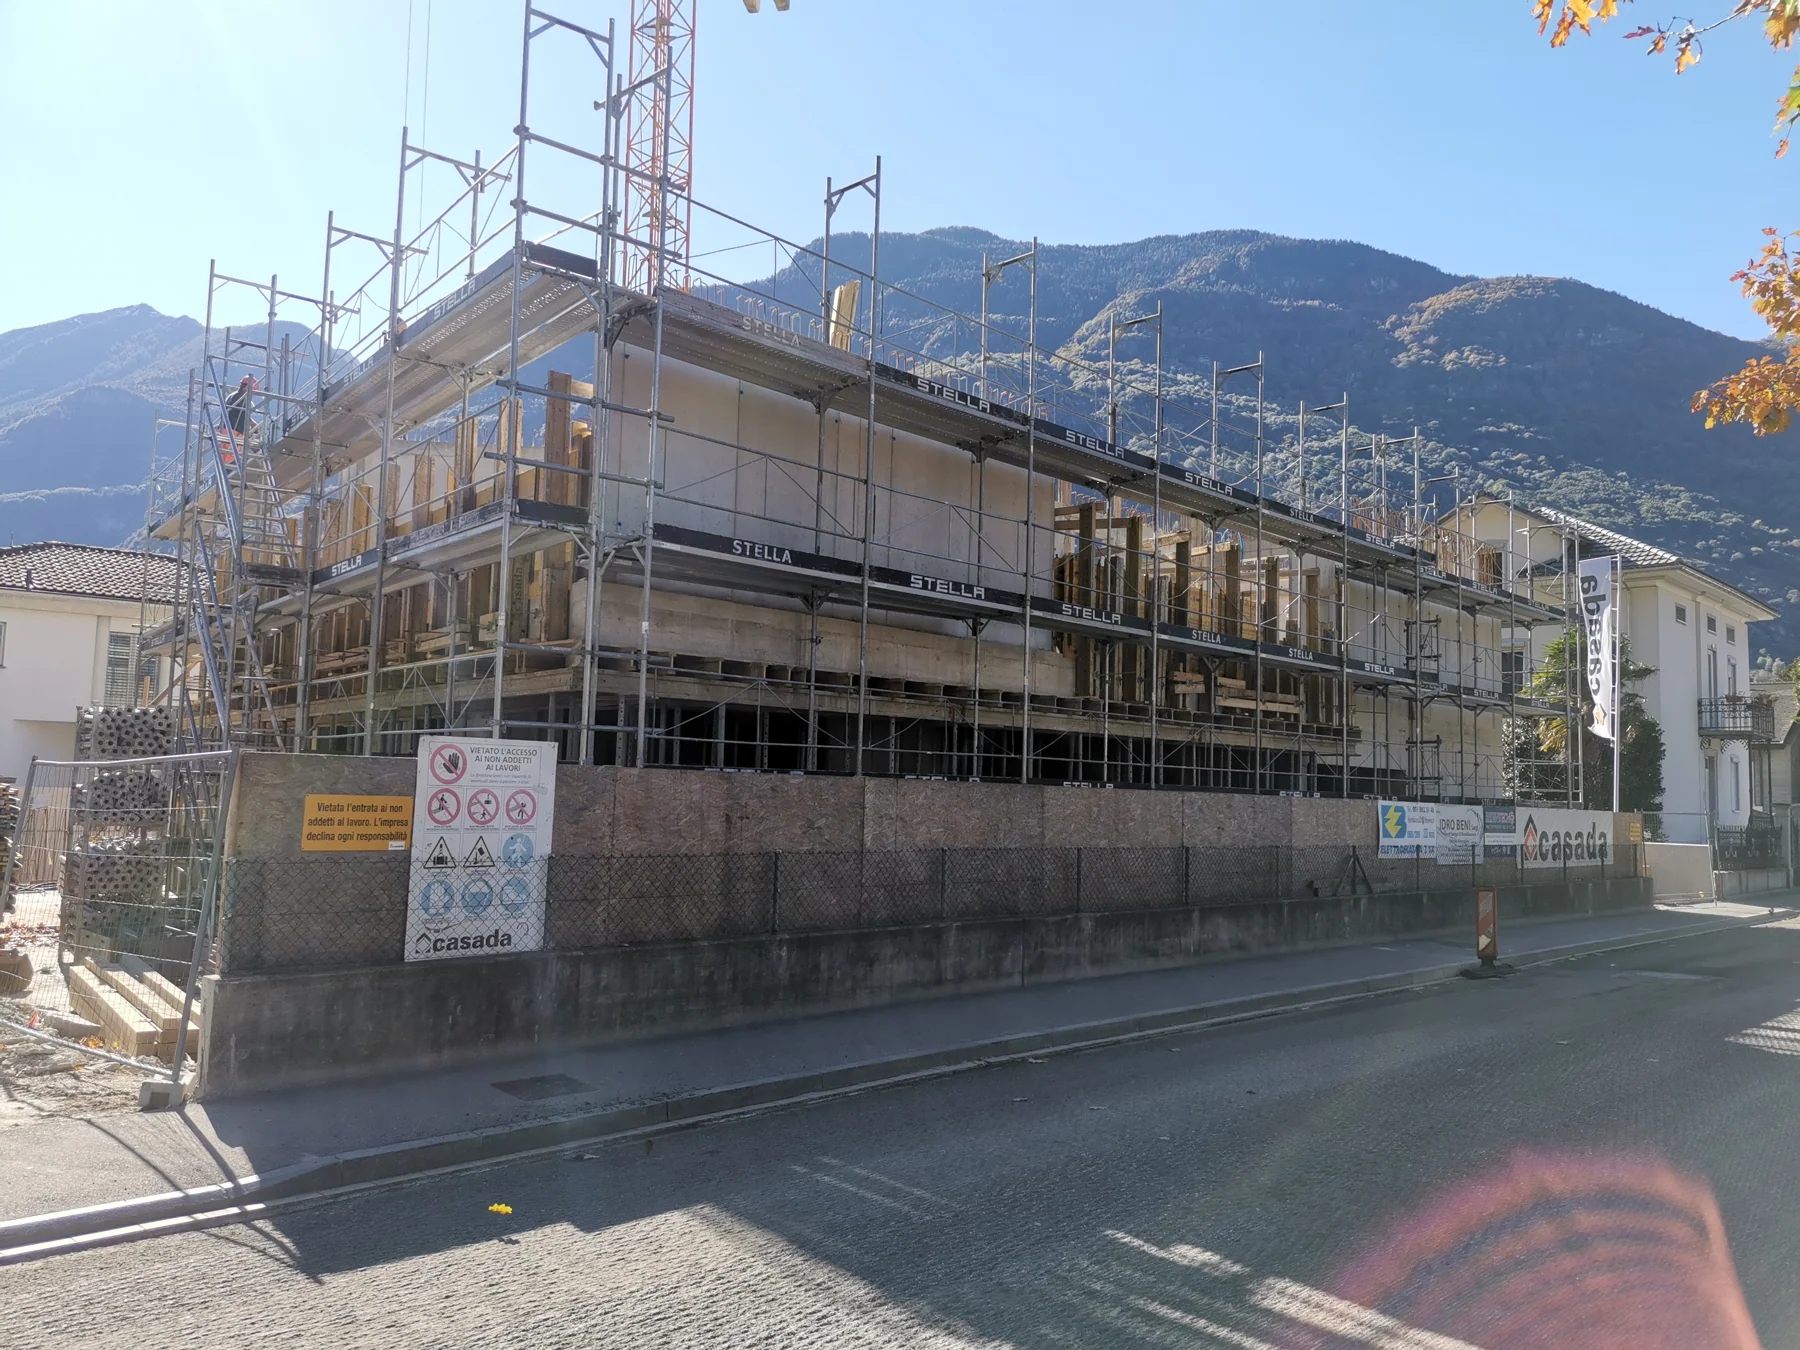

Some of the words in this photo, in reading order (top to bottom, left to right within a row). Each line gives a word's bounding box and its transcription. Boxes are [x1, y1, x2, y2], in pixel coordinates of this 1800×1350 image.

[433, 279, 476, 320] STELLA
[742, 316, 801, 348] STELLA
[344, 356, 374, 386] STELLA
[917, 379, 991, 413] STELLA
[1066, 430, 1125, 459] STELLA
[1185, 471, 1233, 496] STELLA
[1290, 508, 1314, 523] STELLA
[1366, 534, 1395, 549] STELLA
[732, 540, 792, 564] STELLA
[332, 555, 362, 577] STELLA
[1420, 565, 1447, 580] STELLA
[910, 575, 985, 600] STELLA
[1472, 582, 1498, 594] STELLA
[1528, 600, 1550, 611] STELLA
[1062, 603, 1121, 625] STELLA
[1192, 629, 1222, 644] STELLA
[1288, 648, 1313, 660] STELLA
[1364, 663, 1394, 675] STELLA
[1474, 689, 1499, 700] STELLA
[1531, 700, 1550, 708] STELLA
[470, 746, 499, 755] VIETATO
[501, 748, 538, 757] L'ACCESSO
[317, 802, 345, 812] Vietata
[347, 803, 378, 813] l'entrata
[380, 804, 388, 812] ai
[389, 804, 403, 813] non
[307, 817, 336, 827] addetti
[337, 817, 345, 826] al
[347, 817, 372, 826] lavoro.
[374, 818, 409, 829] L'impresa
[1440, 819, 1455, 831] IDRO
[1456, 819, 1471, 830] BENI
[306, 831, 335, 841] declina
[337, 831, 354, 843] ogni
[356, 831, 408, 843] responsabilità
[1539, 822, 1608, 861] casada
[432, 928, 512, 952] casada
